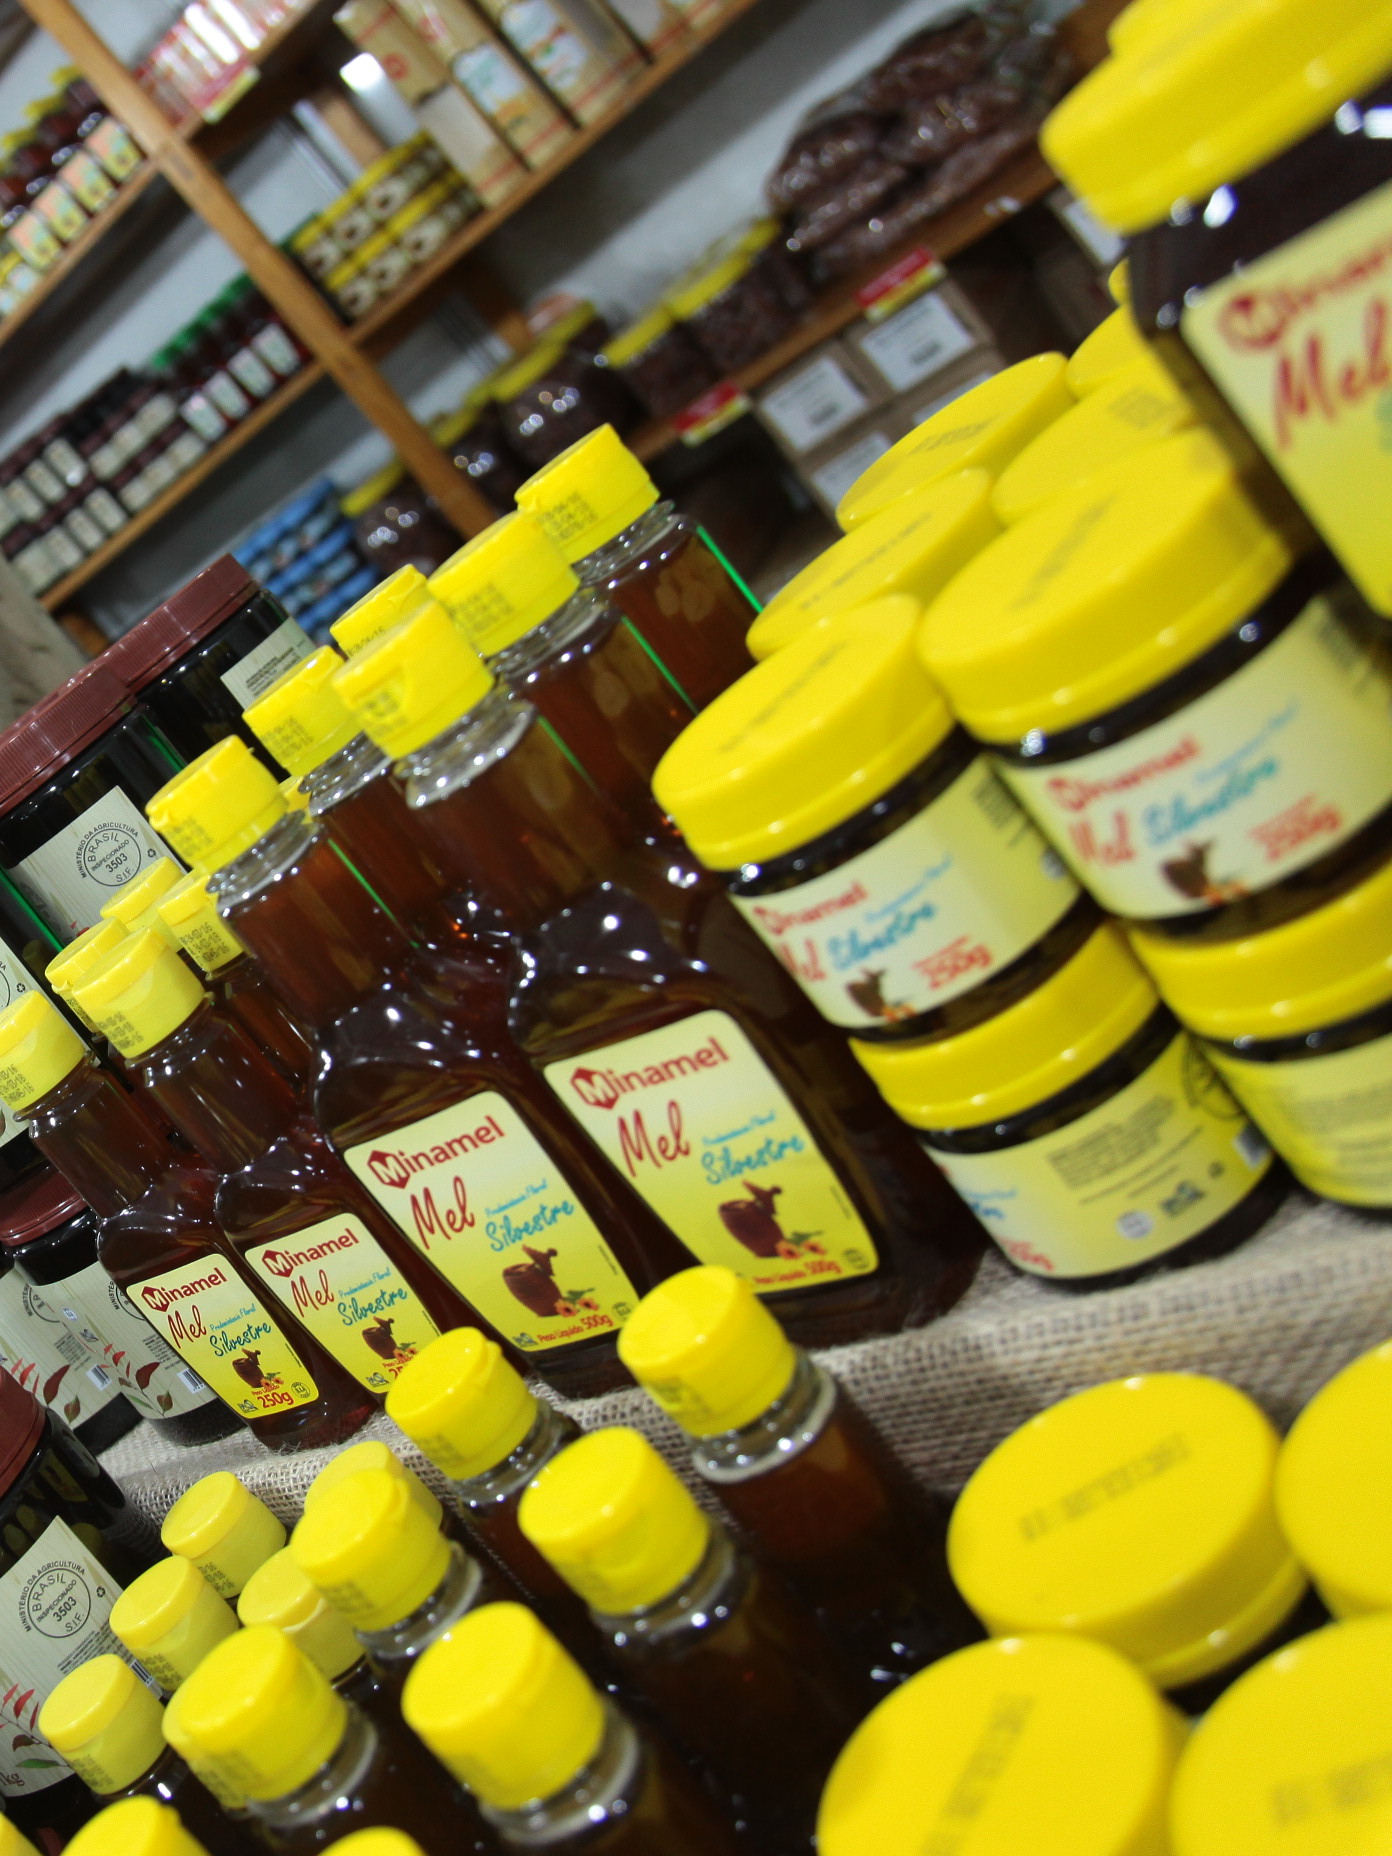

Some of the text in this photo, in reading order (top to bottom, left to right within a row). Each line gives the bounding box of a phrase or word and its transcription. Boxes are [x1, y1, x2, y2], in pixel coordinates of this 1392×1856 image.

[1272, 298, 1391, 450] Mel
[76, 839, 87, 878] MINISTÉRIO
[93, 822, 139, 837] AGRICULTURA
[88, 832, 120, 862] BRASIL
[91, 839, 129, 871] INSPECIONADO
[106, 853, 128, 873] 3503
[570, 1036, 729, 1111] Minamel
[367, 1114, 505, 1189] Minamel
[618, 1100, 690, 1177] Mel
[701, 1135, 805, 1185] Silvestre
[410, 1175, 475, 1251] Mel
[485, 1200, 575, 1252] Silvestre
[261, 1228, 359, 1278] Minamel
[108, 1280, 120, 1310] MINISTÉR
[141, 1267, 227, 1312] Minamel
[291, 1269, 334, 1318] Mel
[338, 1288, 407, 1326] Silvestre
[168, 1305, 207, 1349] Mel
[209, 1323, 271, 1357] Silvestre
[388, 1366, 404, 1380] 25
[257, 1391, 295, 1409] 250g
[18, 1590, 32, 1632] MINISTÉRIO
[37, 1560, 86, 1576] AGRICULTURA
[32, 1572, 67, 1612] BRASIL
[36, 1579, 77, 1622] INSPECIONADO
[53, 1596, 77, 1622] 3503
